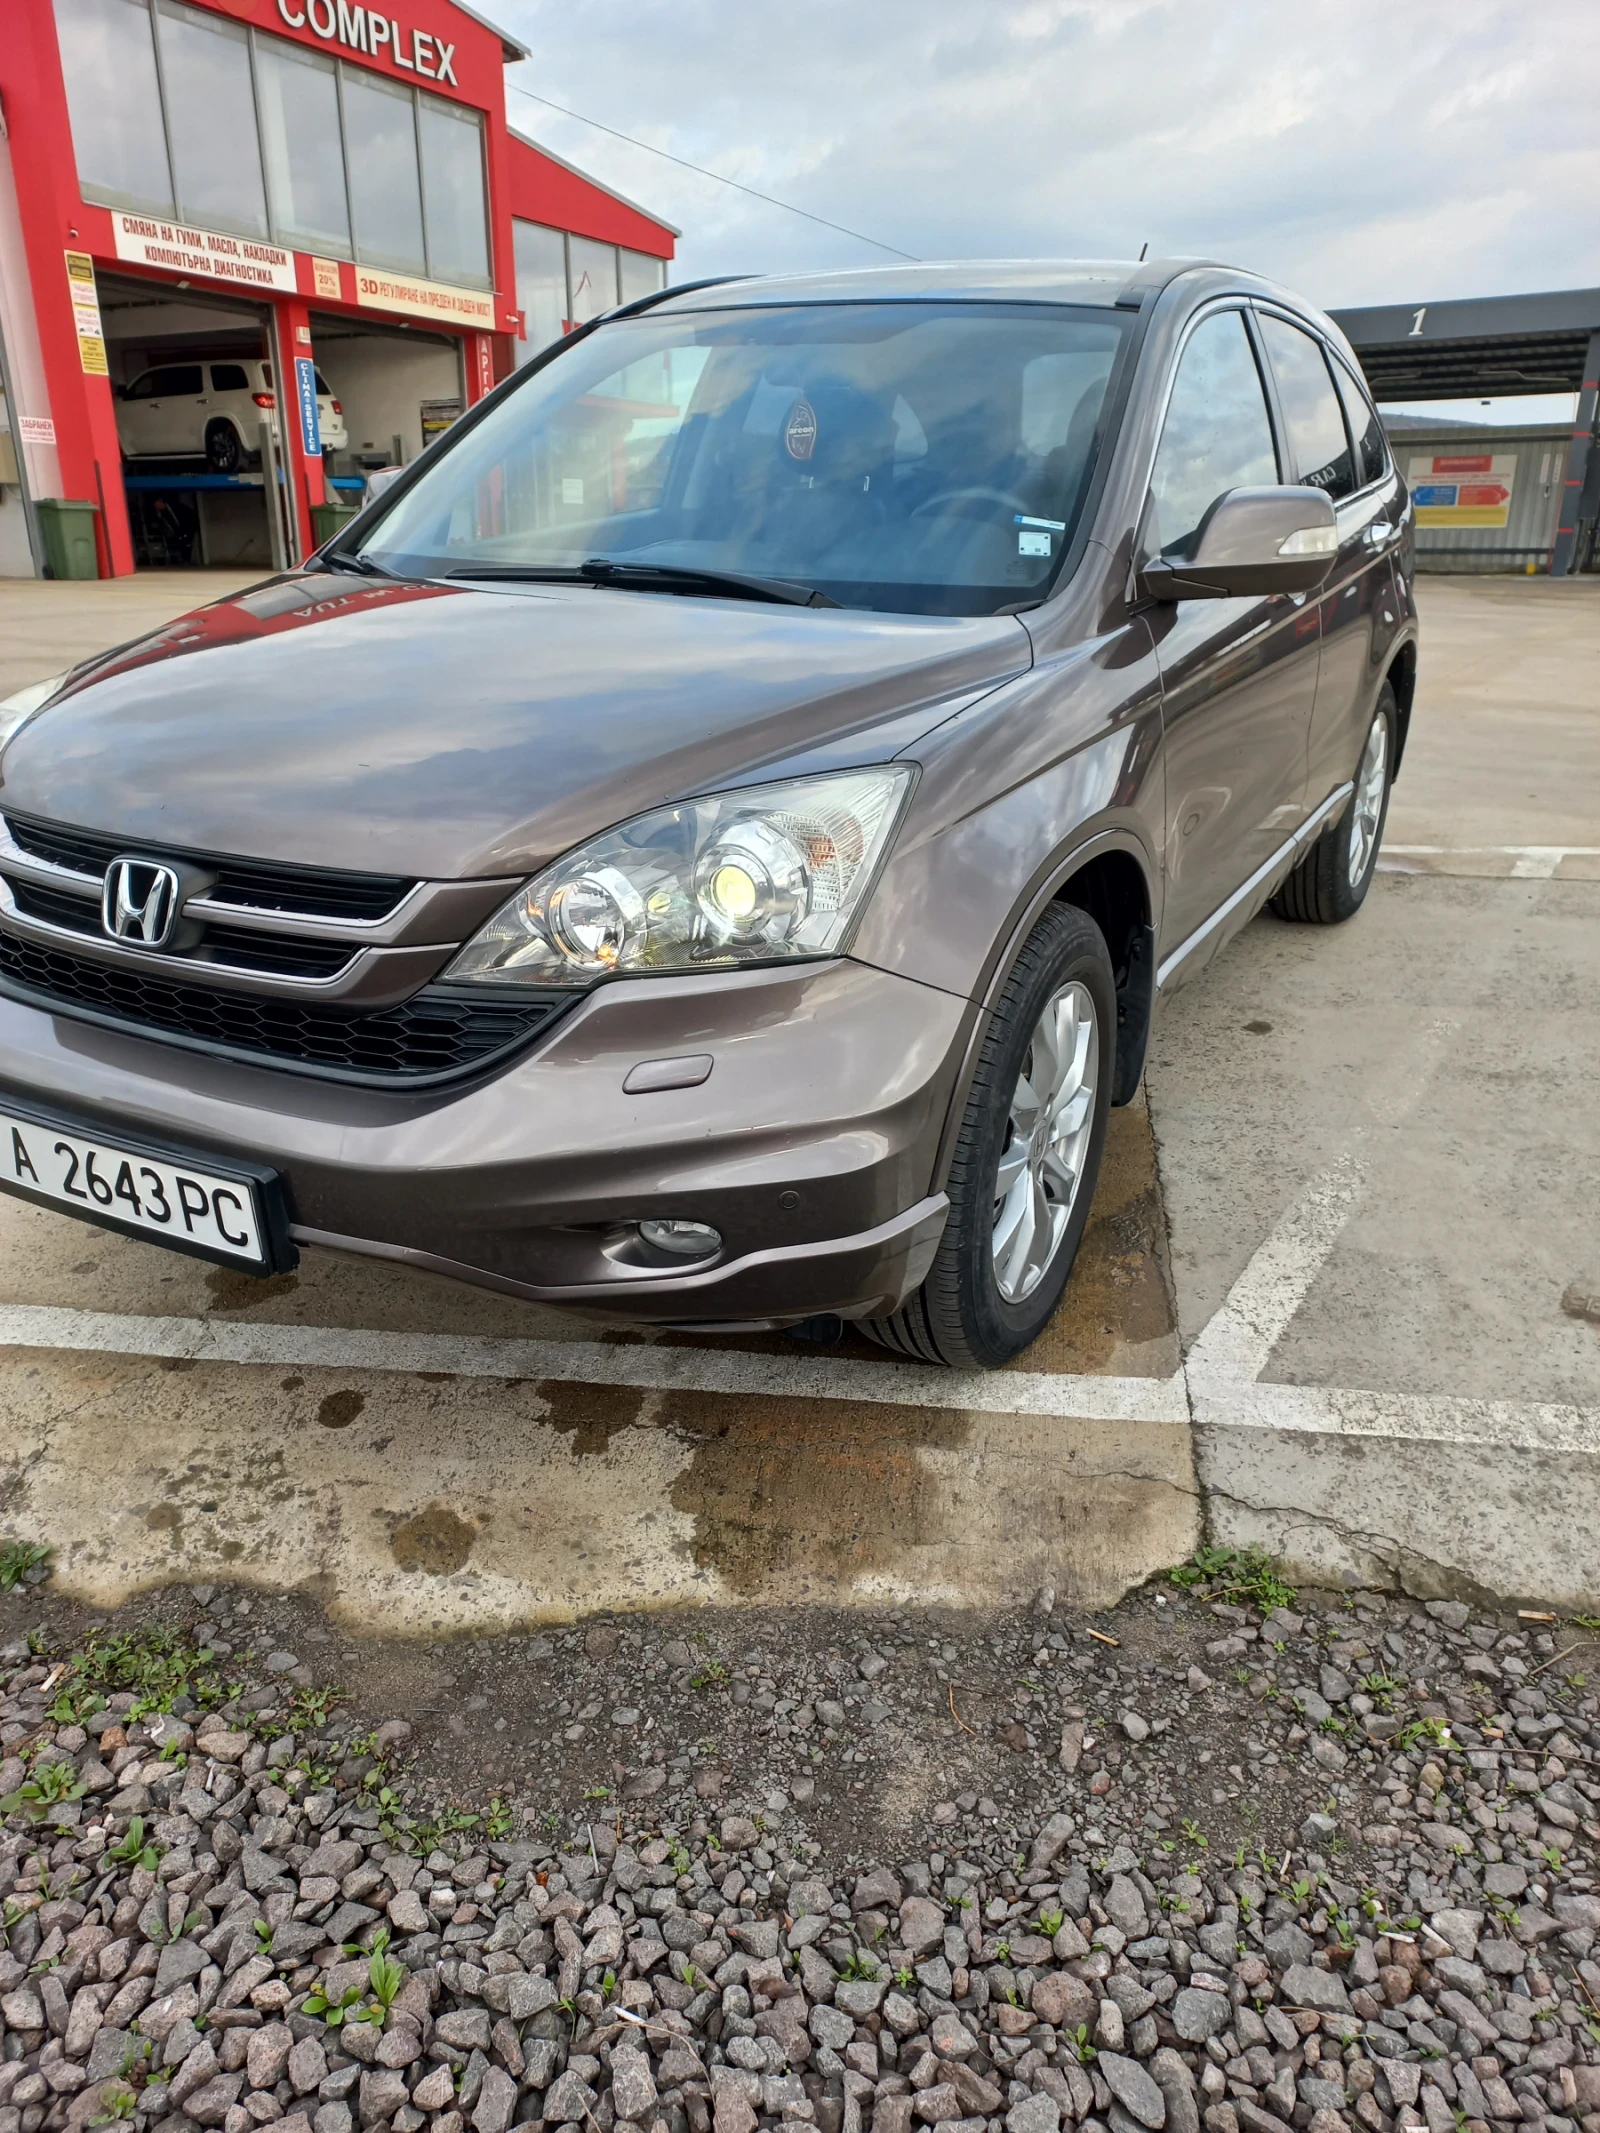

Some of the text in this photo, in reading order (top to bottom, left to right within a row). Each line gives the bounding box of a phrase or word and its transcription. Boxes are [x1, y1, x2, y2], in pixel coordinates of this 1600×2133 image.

[277, 0, 459, 87] COMPLEX
[122, 216, 287, 266] СМЯНА НА ГУМИ, МАСЛА, НАКЛАДКИ
[144, 245, 274, 285] КОМПЮТЪРНА ДИАГНОСТИКА
[360, 277, 378, 295] 3D
[379, 281, 419, 304] РЕГУЛИРАНЕ
[1408, 307, 1427, 336] 1
[300, 362, 317, 452] CLIMA SERVICE
[11, 1126, 41, 1184] A
